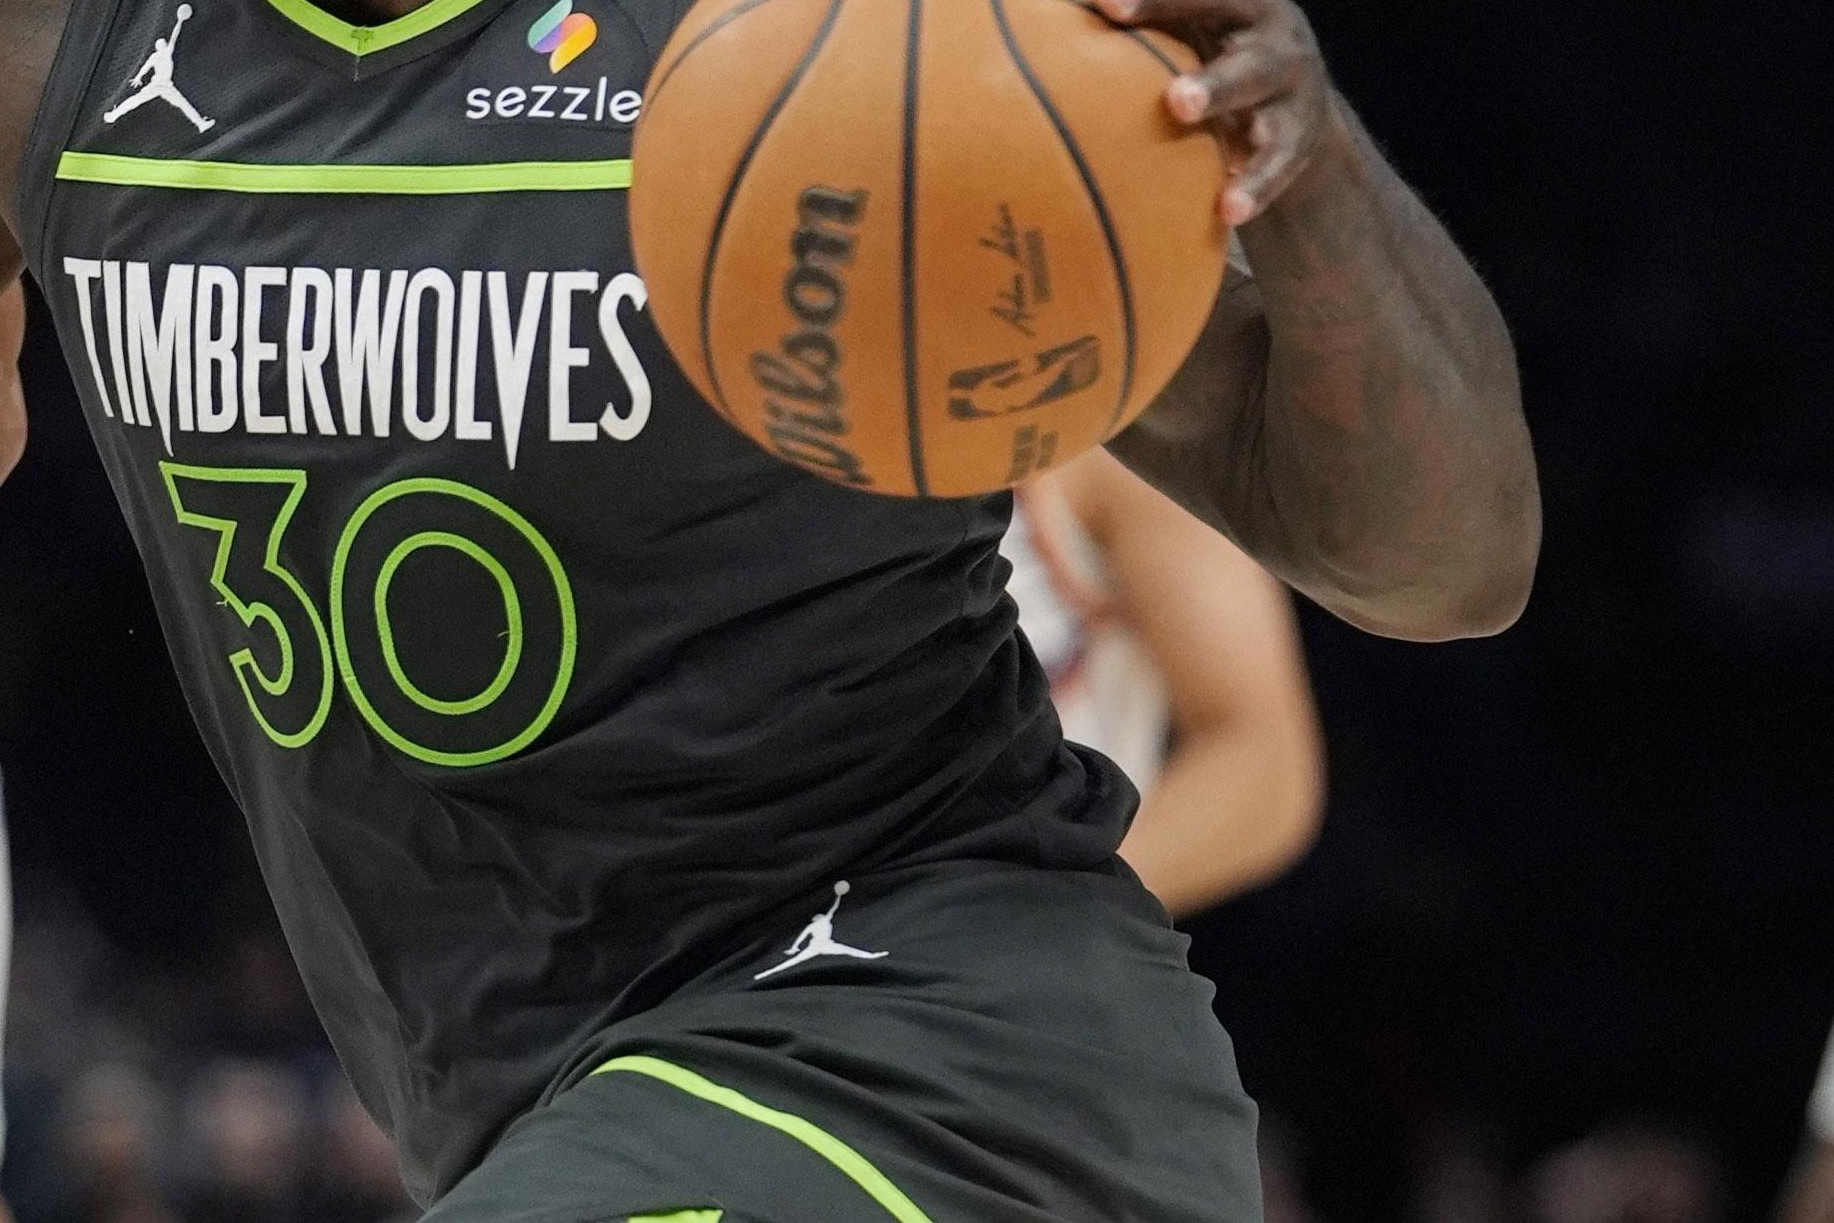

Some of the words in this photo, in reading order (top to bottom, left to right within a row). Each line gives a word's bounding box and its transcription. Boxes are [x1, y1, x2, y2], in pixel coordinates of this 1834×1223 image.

[466, 76, 642, 123] sezzle
[63, 256, 653, 471] TIMBERWOLVES
[159, 460, 578, 768] 30
